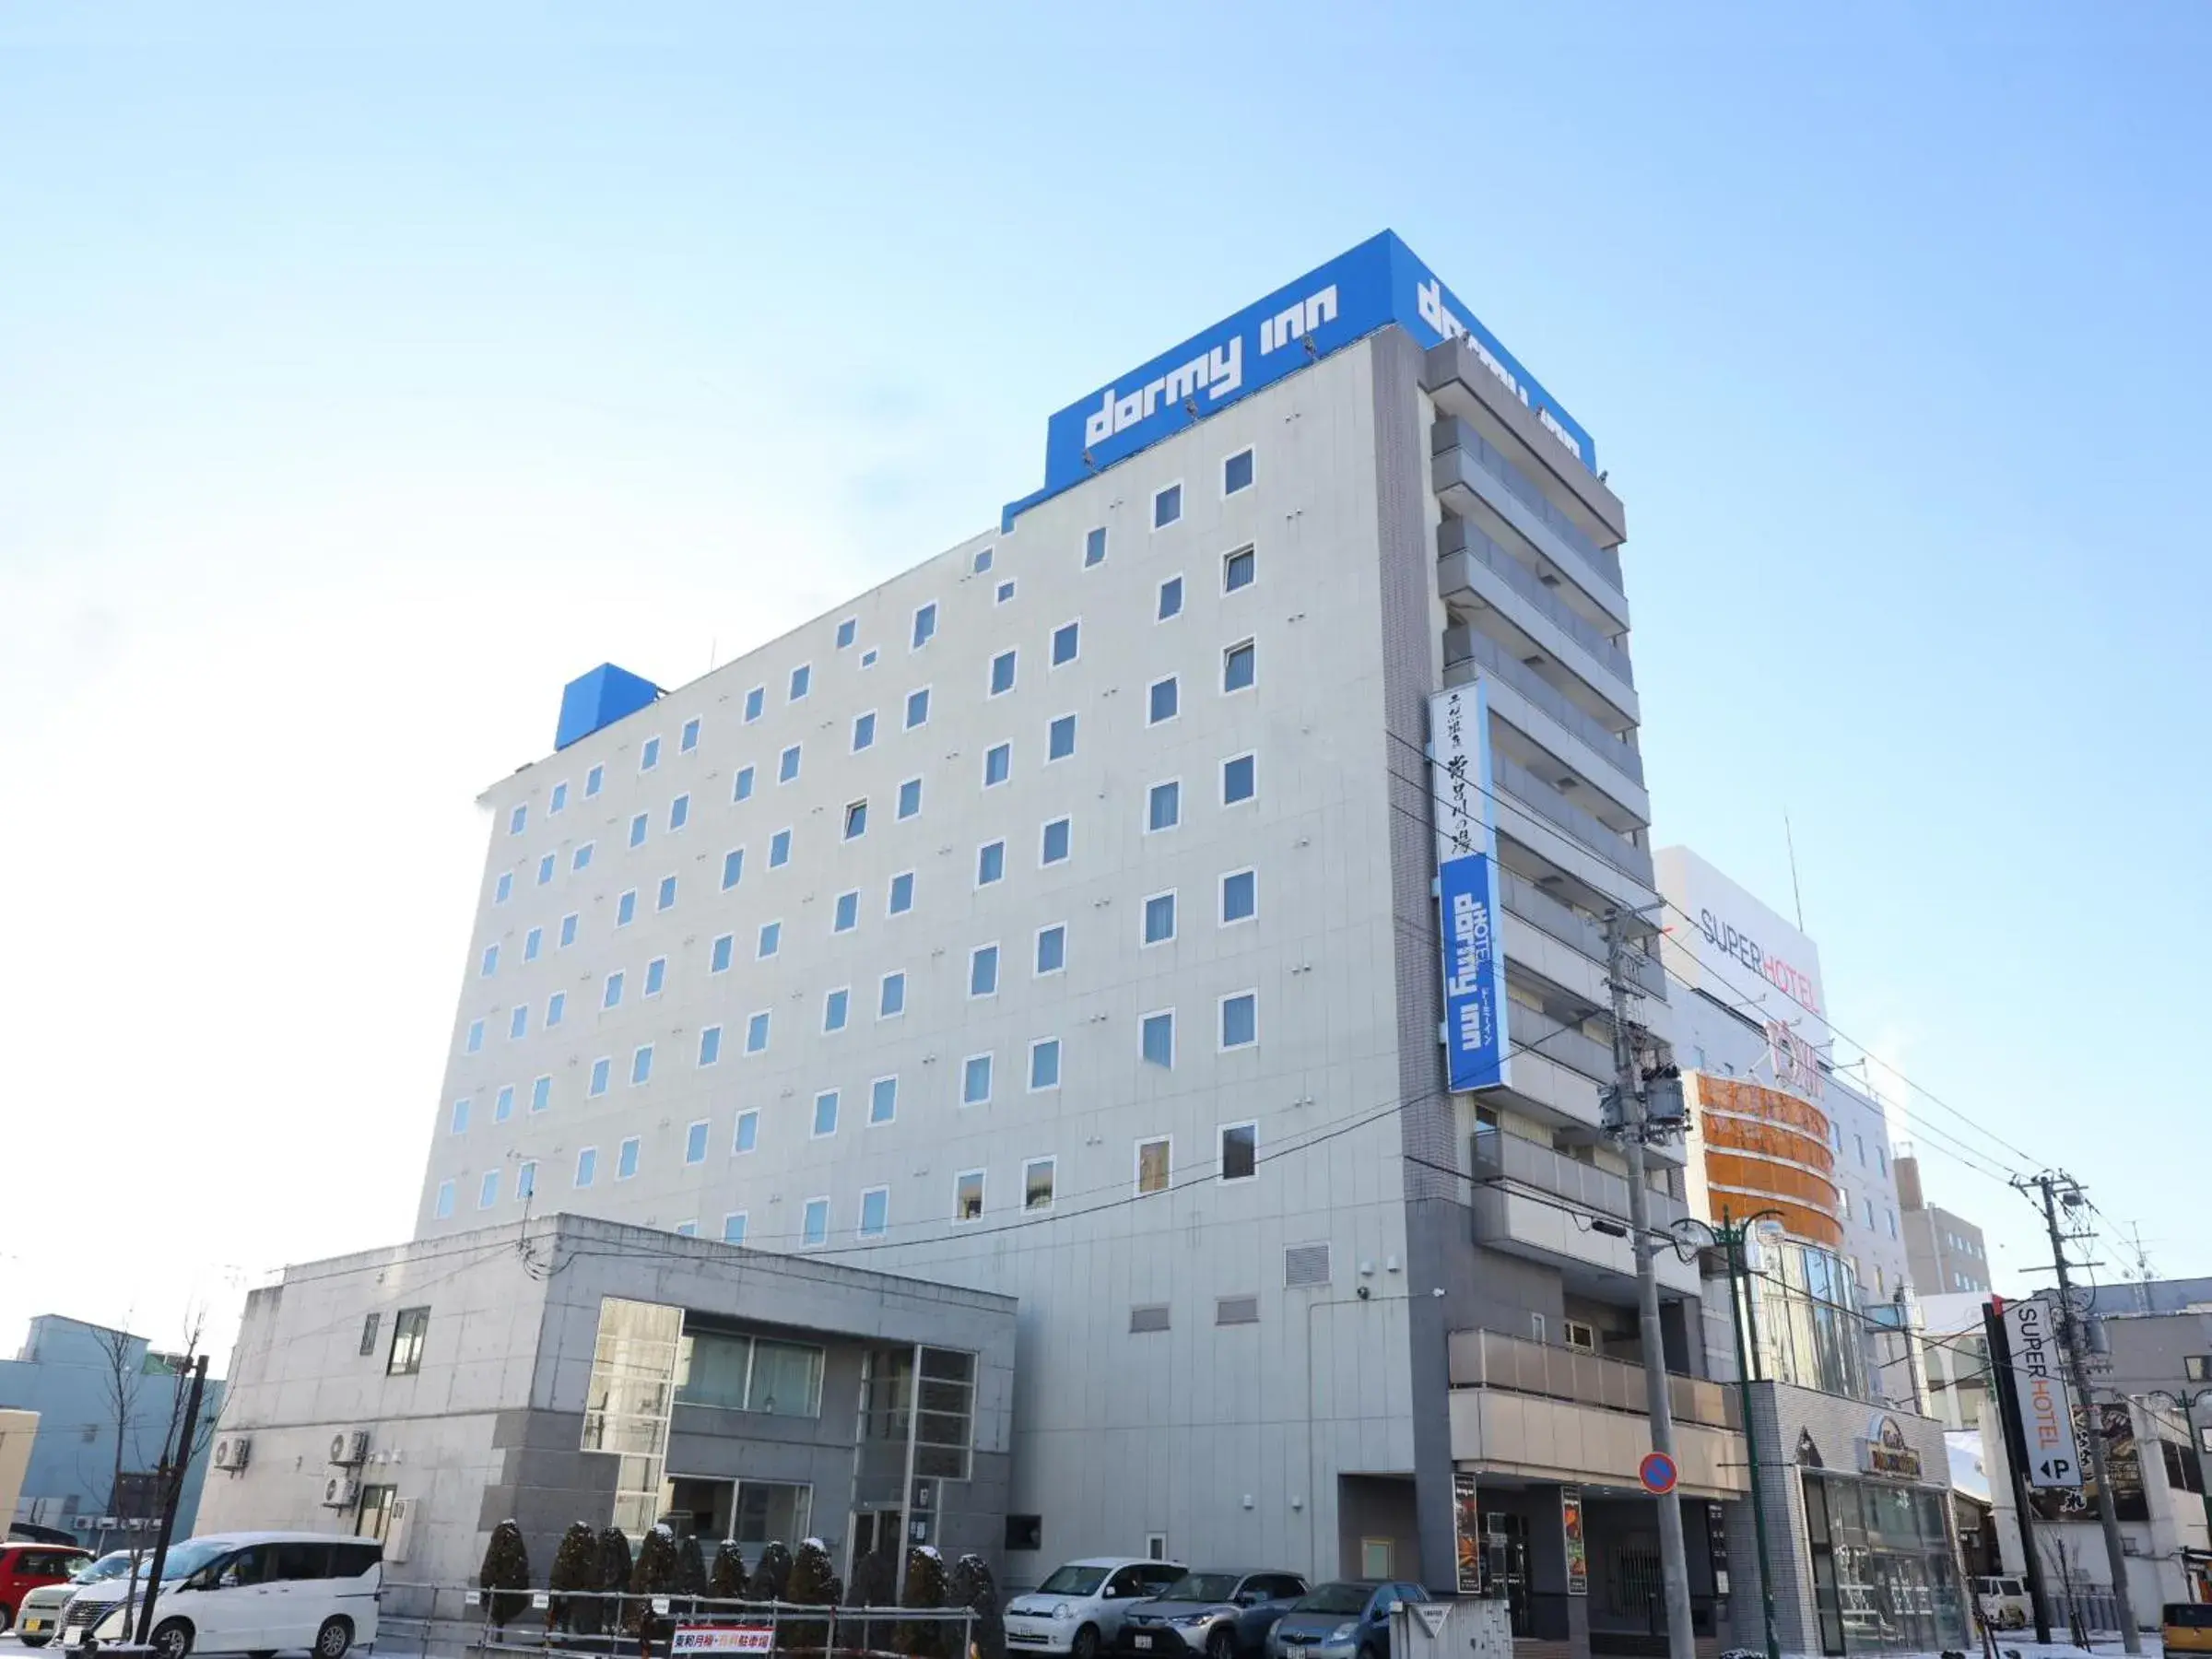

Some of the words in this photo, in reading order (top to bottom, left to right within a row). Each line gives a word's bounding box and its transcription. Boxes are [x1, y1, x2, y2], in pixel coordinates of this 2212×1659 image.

[1085, 333, 1242, 449] dormy
[1260, 284, 1337, 357] inn
[1449, 892, 1482, 997] dormy
[1460, 1003, 1481, 1051] inn
[2053, 1459, 2070, 1479] P
